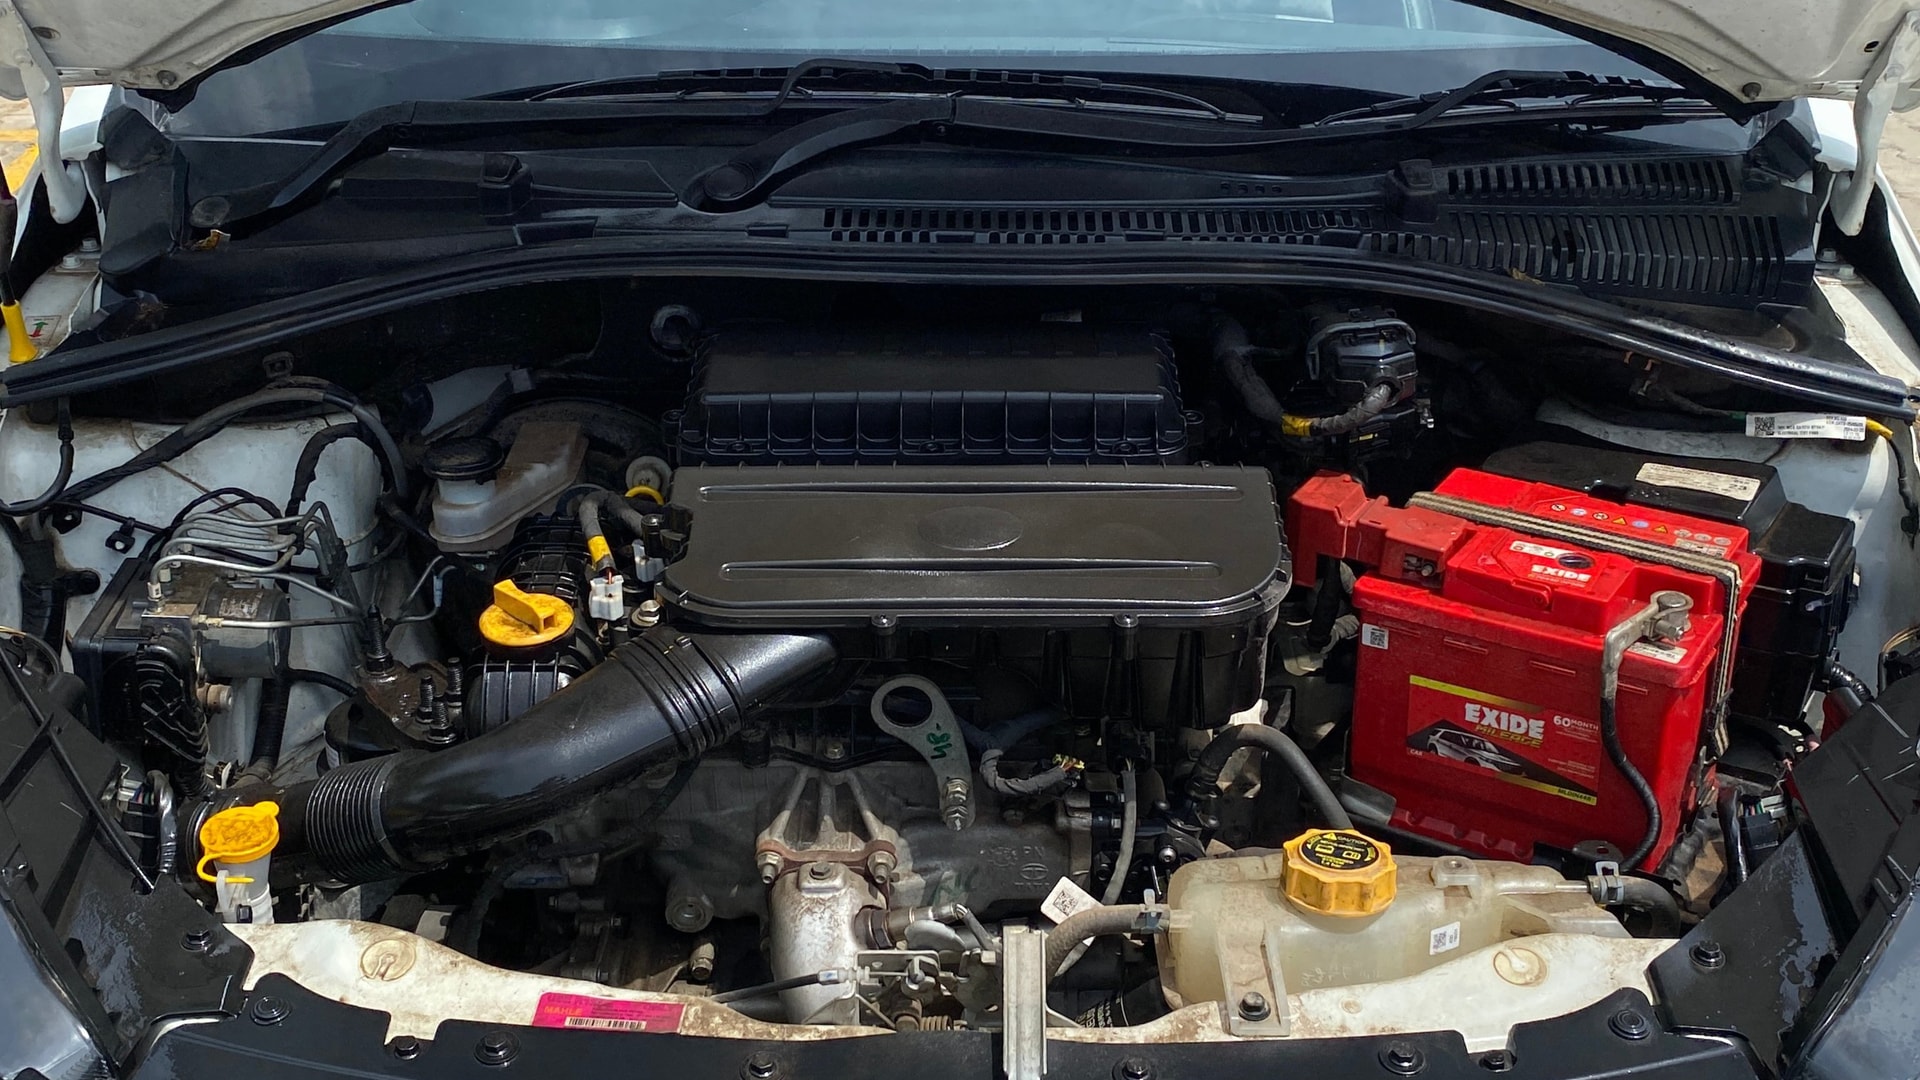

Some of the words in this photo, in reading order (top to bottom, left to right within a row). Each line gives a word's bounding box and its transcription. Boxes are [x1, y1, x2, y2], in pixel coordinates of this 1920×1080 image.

[1465, 703, 1545, 739] EXIDE
[1553, 715, 1571, 727] 60
[1571, 719, 1599, 731] MONTH
[1475, 725, 1543, 748] MILEAGE
[544, 1005, 583, 1016] MAHLE
